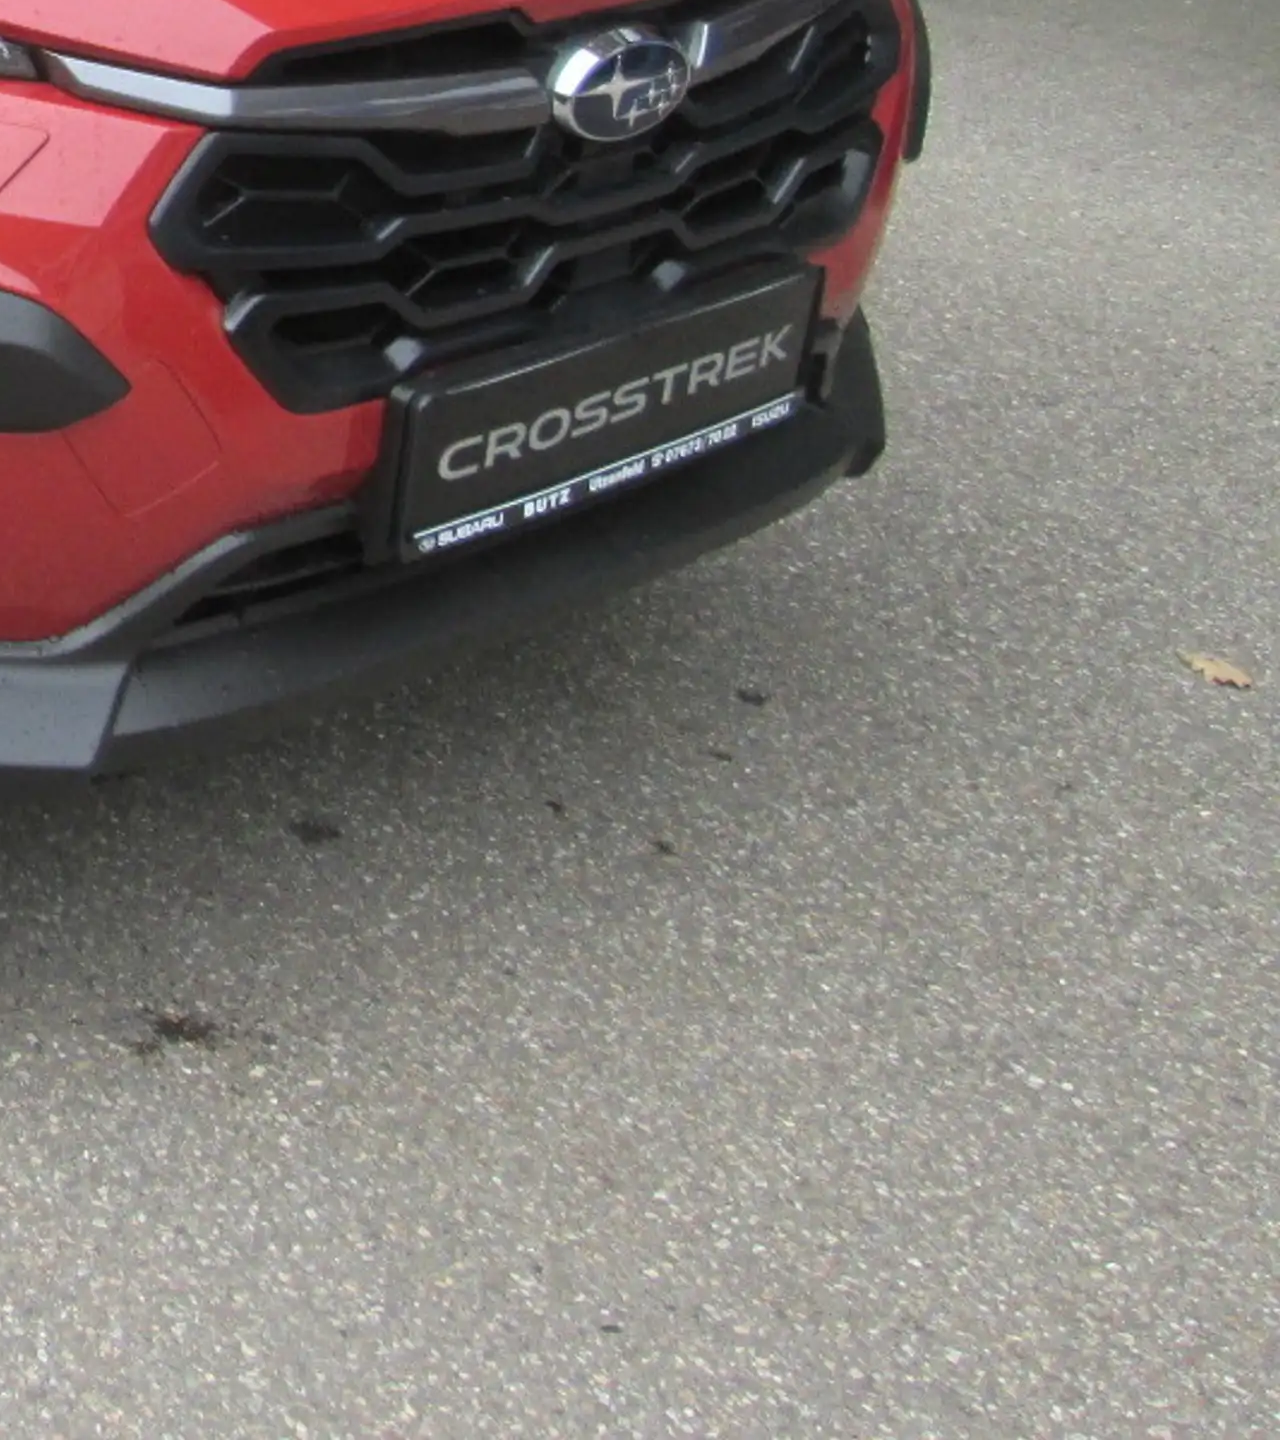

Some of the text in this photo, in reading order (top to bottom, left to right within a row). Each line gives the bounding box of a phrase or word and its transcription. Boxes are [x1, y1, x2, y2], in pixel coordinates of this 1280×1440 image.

[437, 324, 793, 481] CROSSTREK
[438, 512, 504, 547] SUBARU
[523, 488, 571, 519] BUTZ
[751, 403, 790, 429] ISUZU
